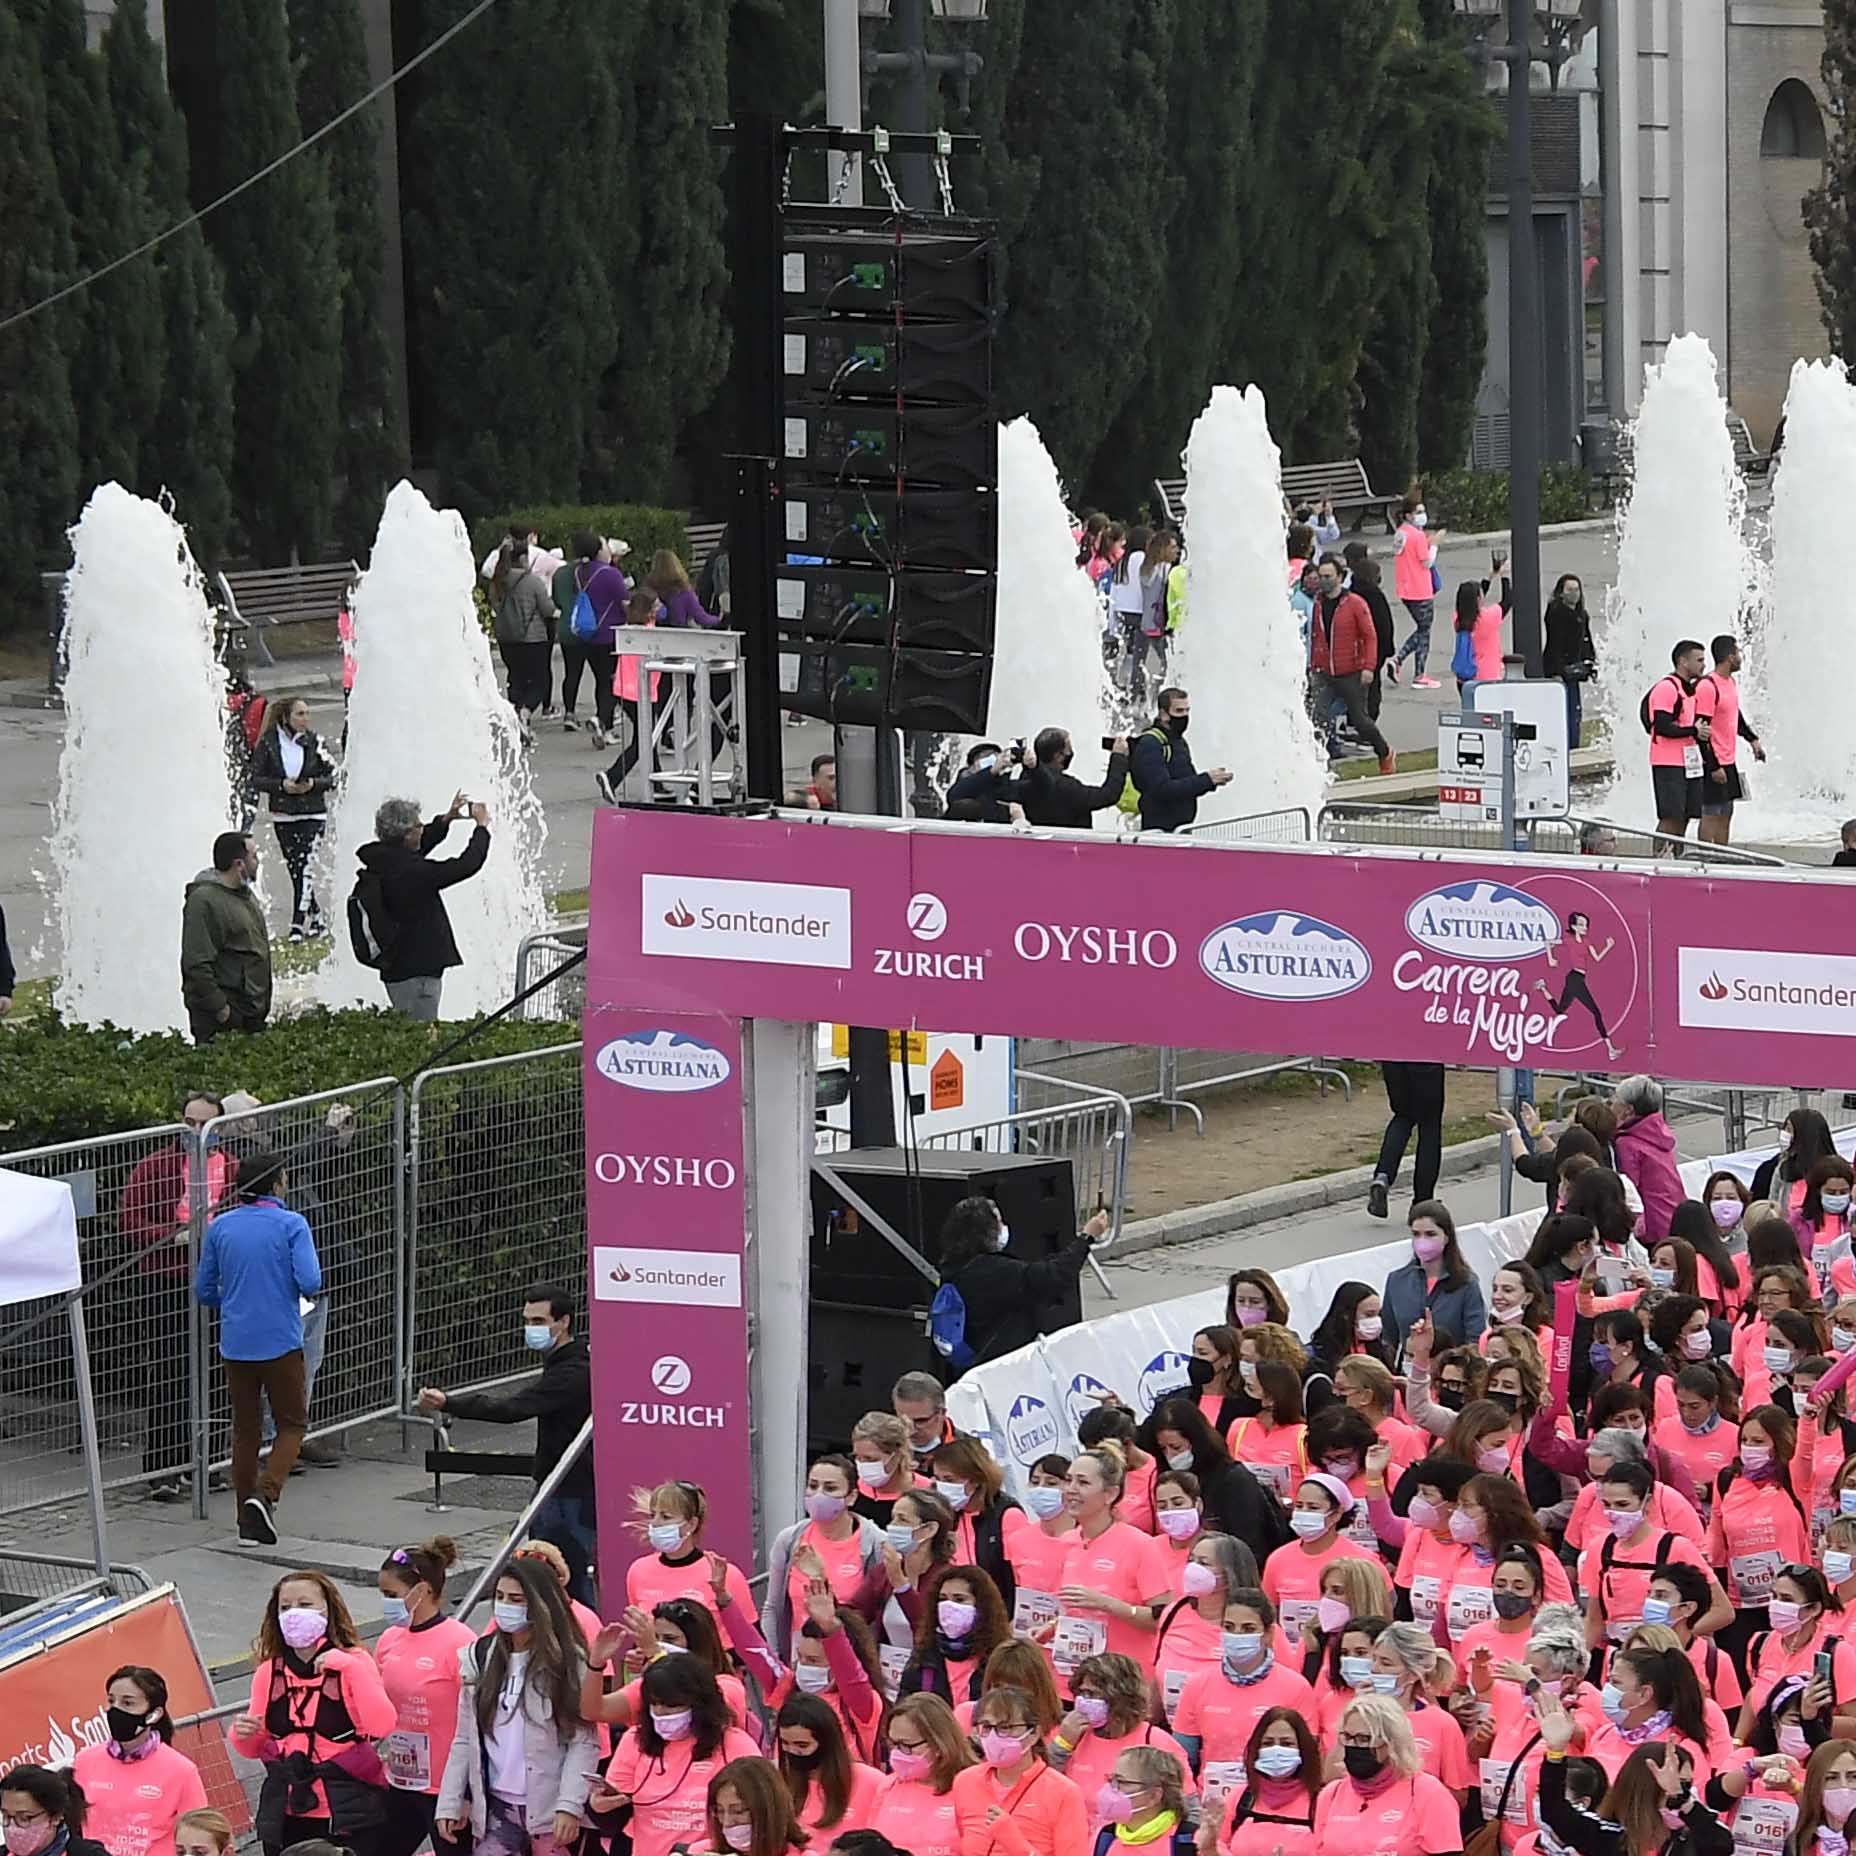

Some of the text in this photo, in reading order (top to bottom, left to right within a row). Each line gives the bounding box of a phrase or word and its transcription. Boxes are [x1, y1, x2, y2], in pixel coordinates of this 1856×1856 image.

[1444, 790, 1456, 800] 13
[1464, 791, 1477, 801] 23
[700, 905, 831, 939] Santander
[1418, 910, 1548, 942] ASTURIANA
[1014, 922, 1177, 969] OYSHO
[1214, 942, 1357, 979] ASTURIANA
[874, 949, 984, 981] ZURICH
[1393, 951, 1520, 994] Carrera
[1425, 993, 1568, 1062] de la Mujer
[605, 1049, 721, 1079] ASTURIANA
[595, 1153, 735, 1189] OYSHO
[635, 1267, 726, 1288] Santander
[621, 1403, 724, 1427] ZURICH
